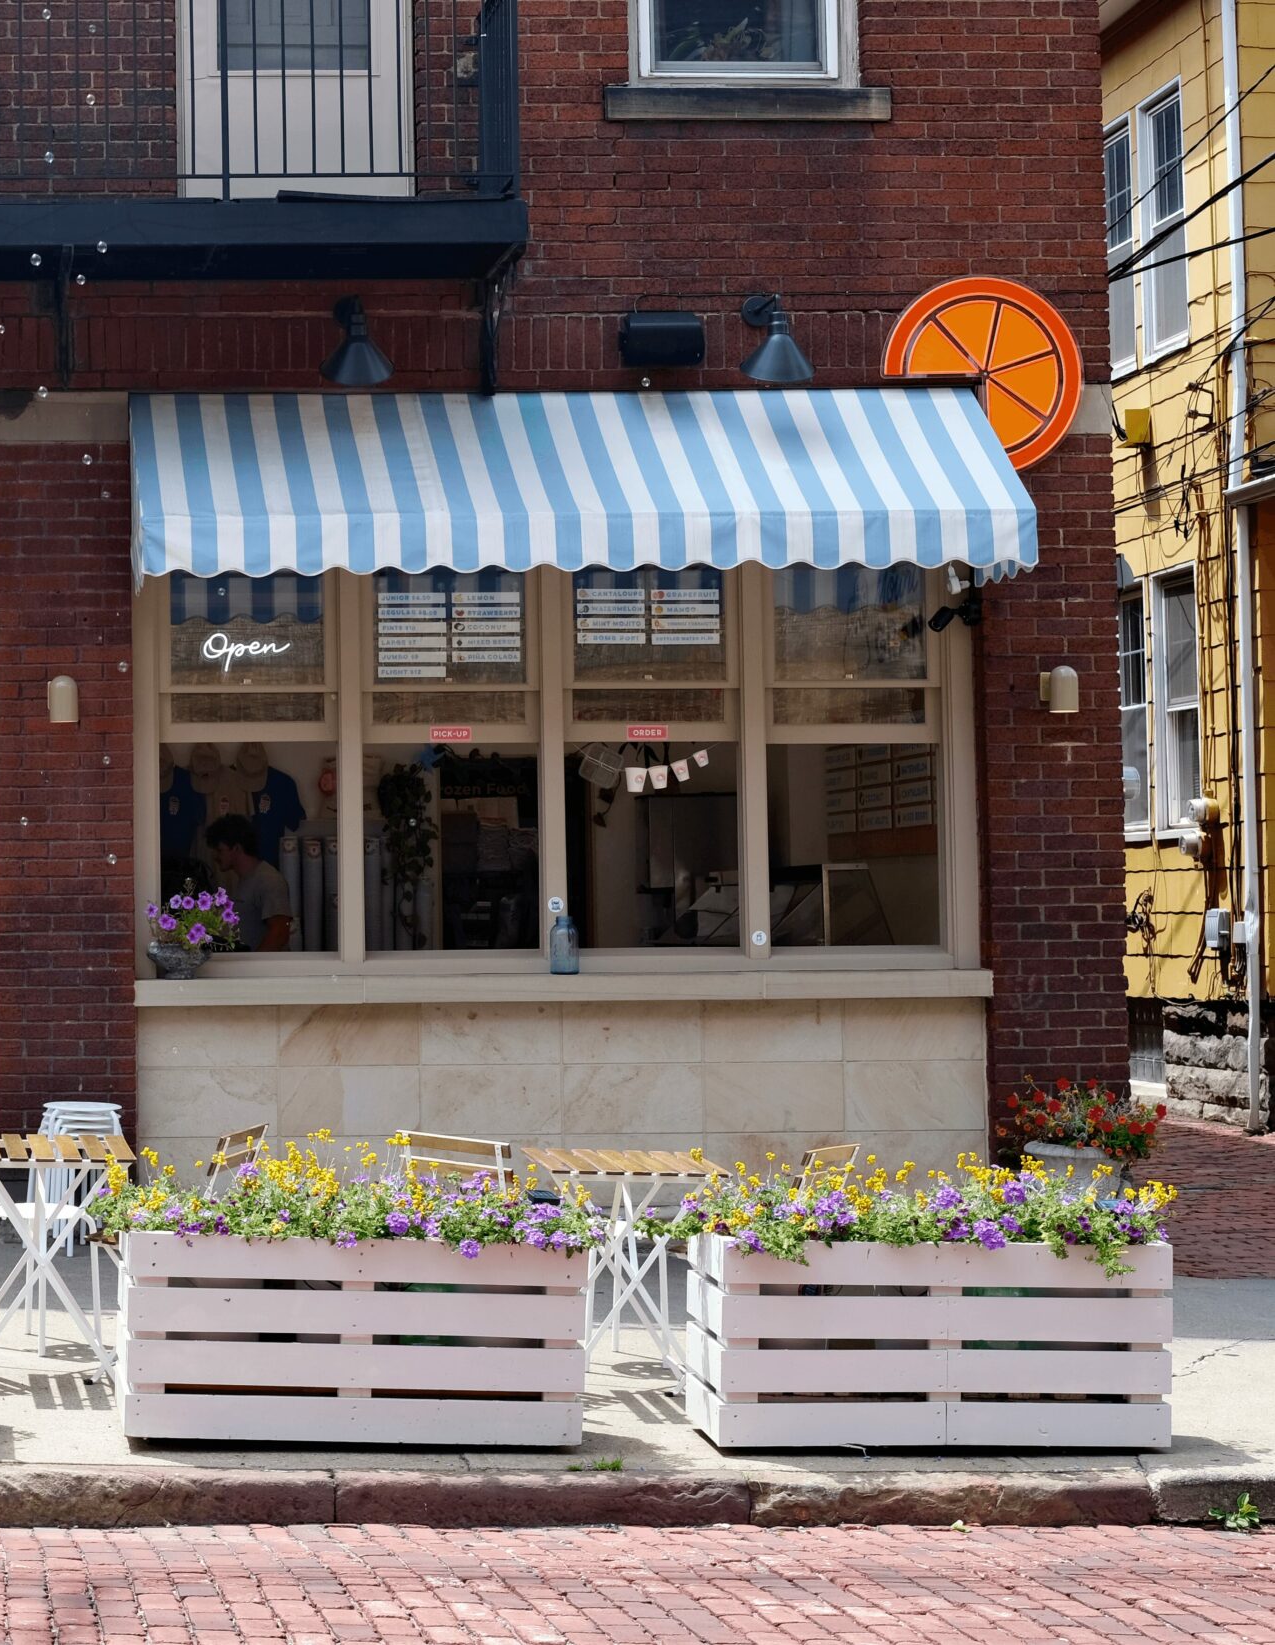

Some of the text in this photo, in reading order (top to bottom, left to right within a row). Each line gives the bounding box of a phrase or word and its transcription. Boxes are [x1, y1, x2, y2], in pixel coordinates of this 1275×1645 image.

[203, 632, 291, 673] Open
[433, 730, 468, 739] PICK-UP
[632, 729, 663, 737] ORDER
[440, 784, 481, 796] ozen
